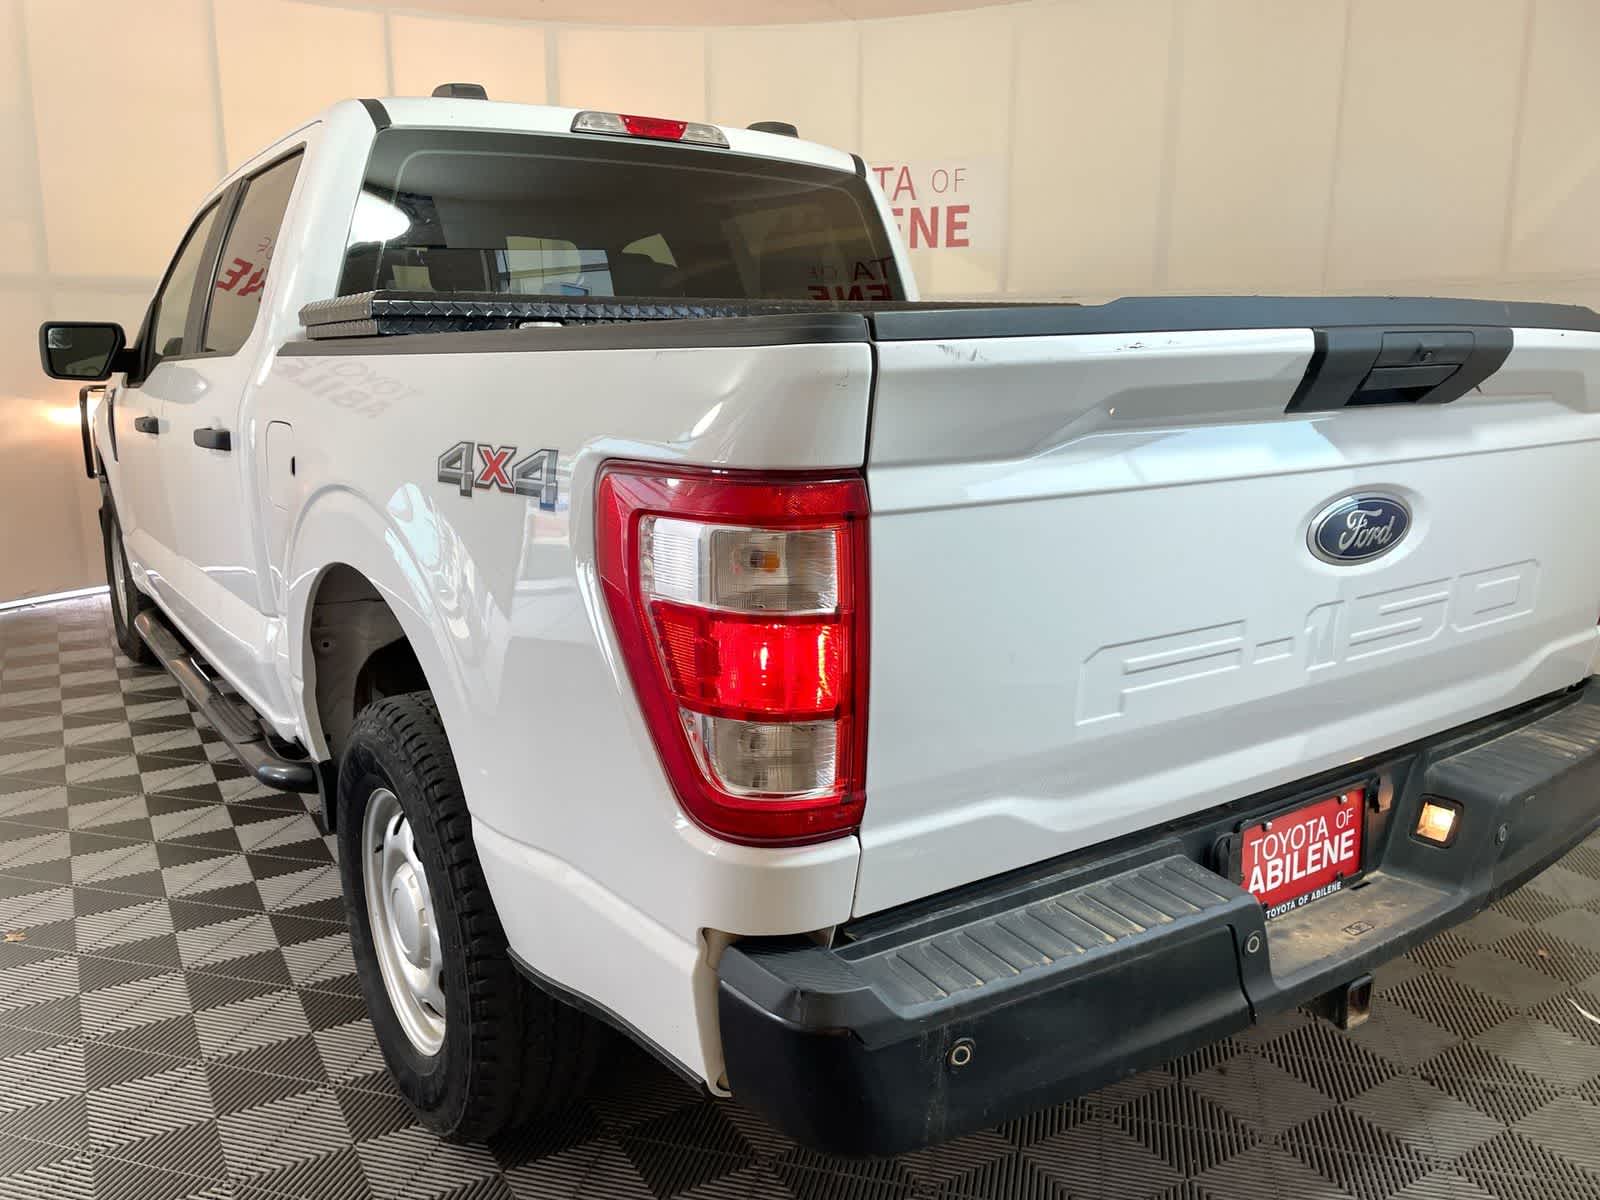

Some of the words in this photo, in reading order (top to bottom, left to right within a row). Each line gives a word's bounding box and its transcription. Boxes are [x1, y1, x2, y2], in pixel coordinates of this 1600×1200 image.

[931, 167, 967, 194] OF
[1338, 508, 1396, 552] Ford
[1075, 558, 1542, 728] F-150
[1248, 828, 1356, 894] ABILENE
[1250, 815, 1329, 865] TOYOTA
[1335, 808, 1354, 829] OF
[1265, 902, 1296, 920] TOYOTA
[1298, 894, 1309, 907] OF
[1311, 881, 1342, 900] ABILENE
